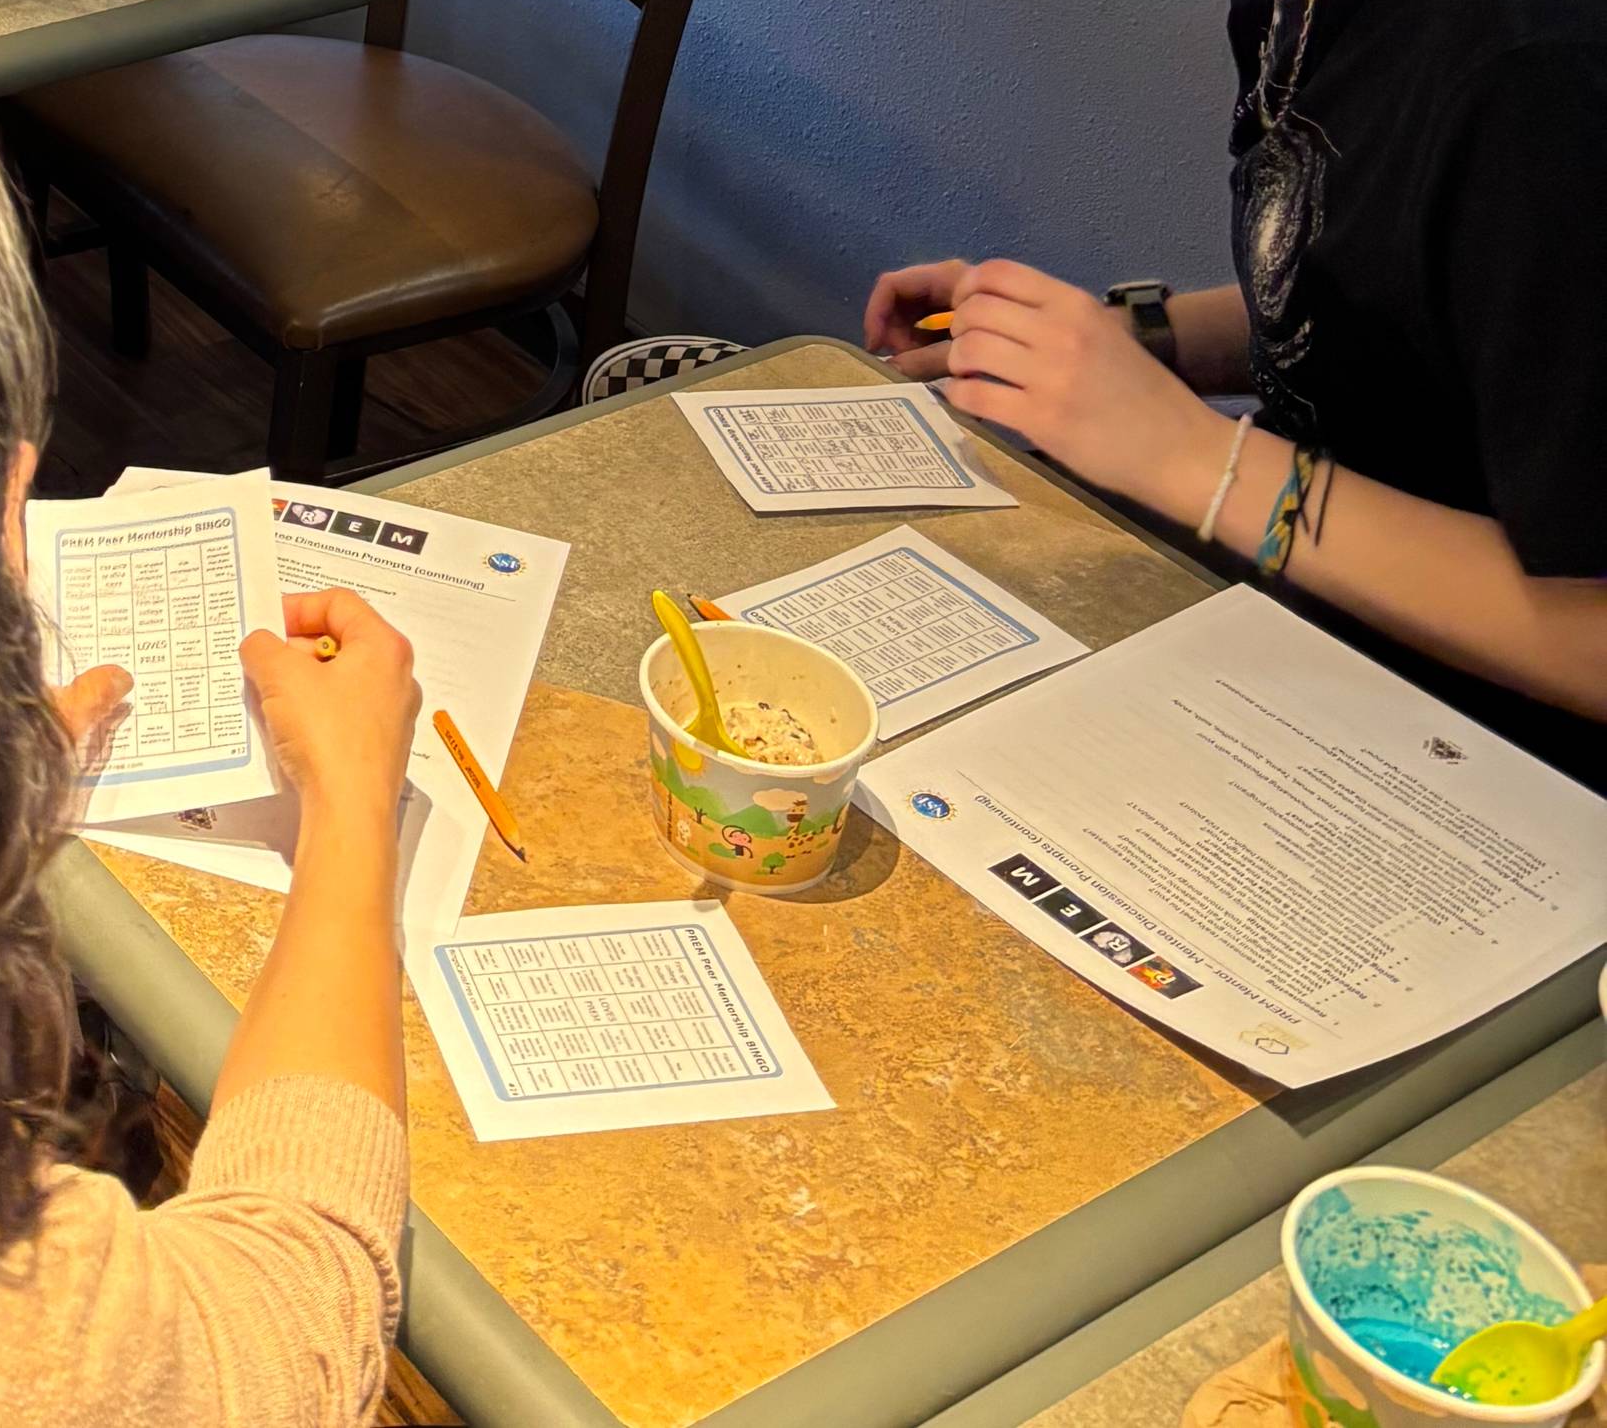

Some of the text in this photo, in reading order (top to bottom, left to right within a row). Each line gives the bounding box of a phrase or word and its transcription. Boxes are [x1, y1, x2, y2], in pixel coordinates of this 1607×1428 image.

[349, 522, 360, 532] E
[390, 532, 413, 546] M
[295, 535, 359, 558] Discussion
[361, 552, 412, 572] Prompts
[969, 793, 1045, 846] (continuing)
[1036, 841, 1094, 882] Prompts
[1086, 879, 1158, 931] Discussion
[1152, 927, 1205, 965] Mentee
[685, 929, 770, 1073] PREM Peer Mentorship BINGO
[1210, 966, 1260, 1002] Mentor
[598, 997, 618, 1022] LOVES
[1256, 995, 1301, 1028] PREM
